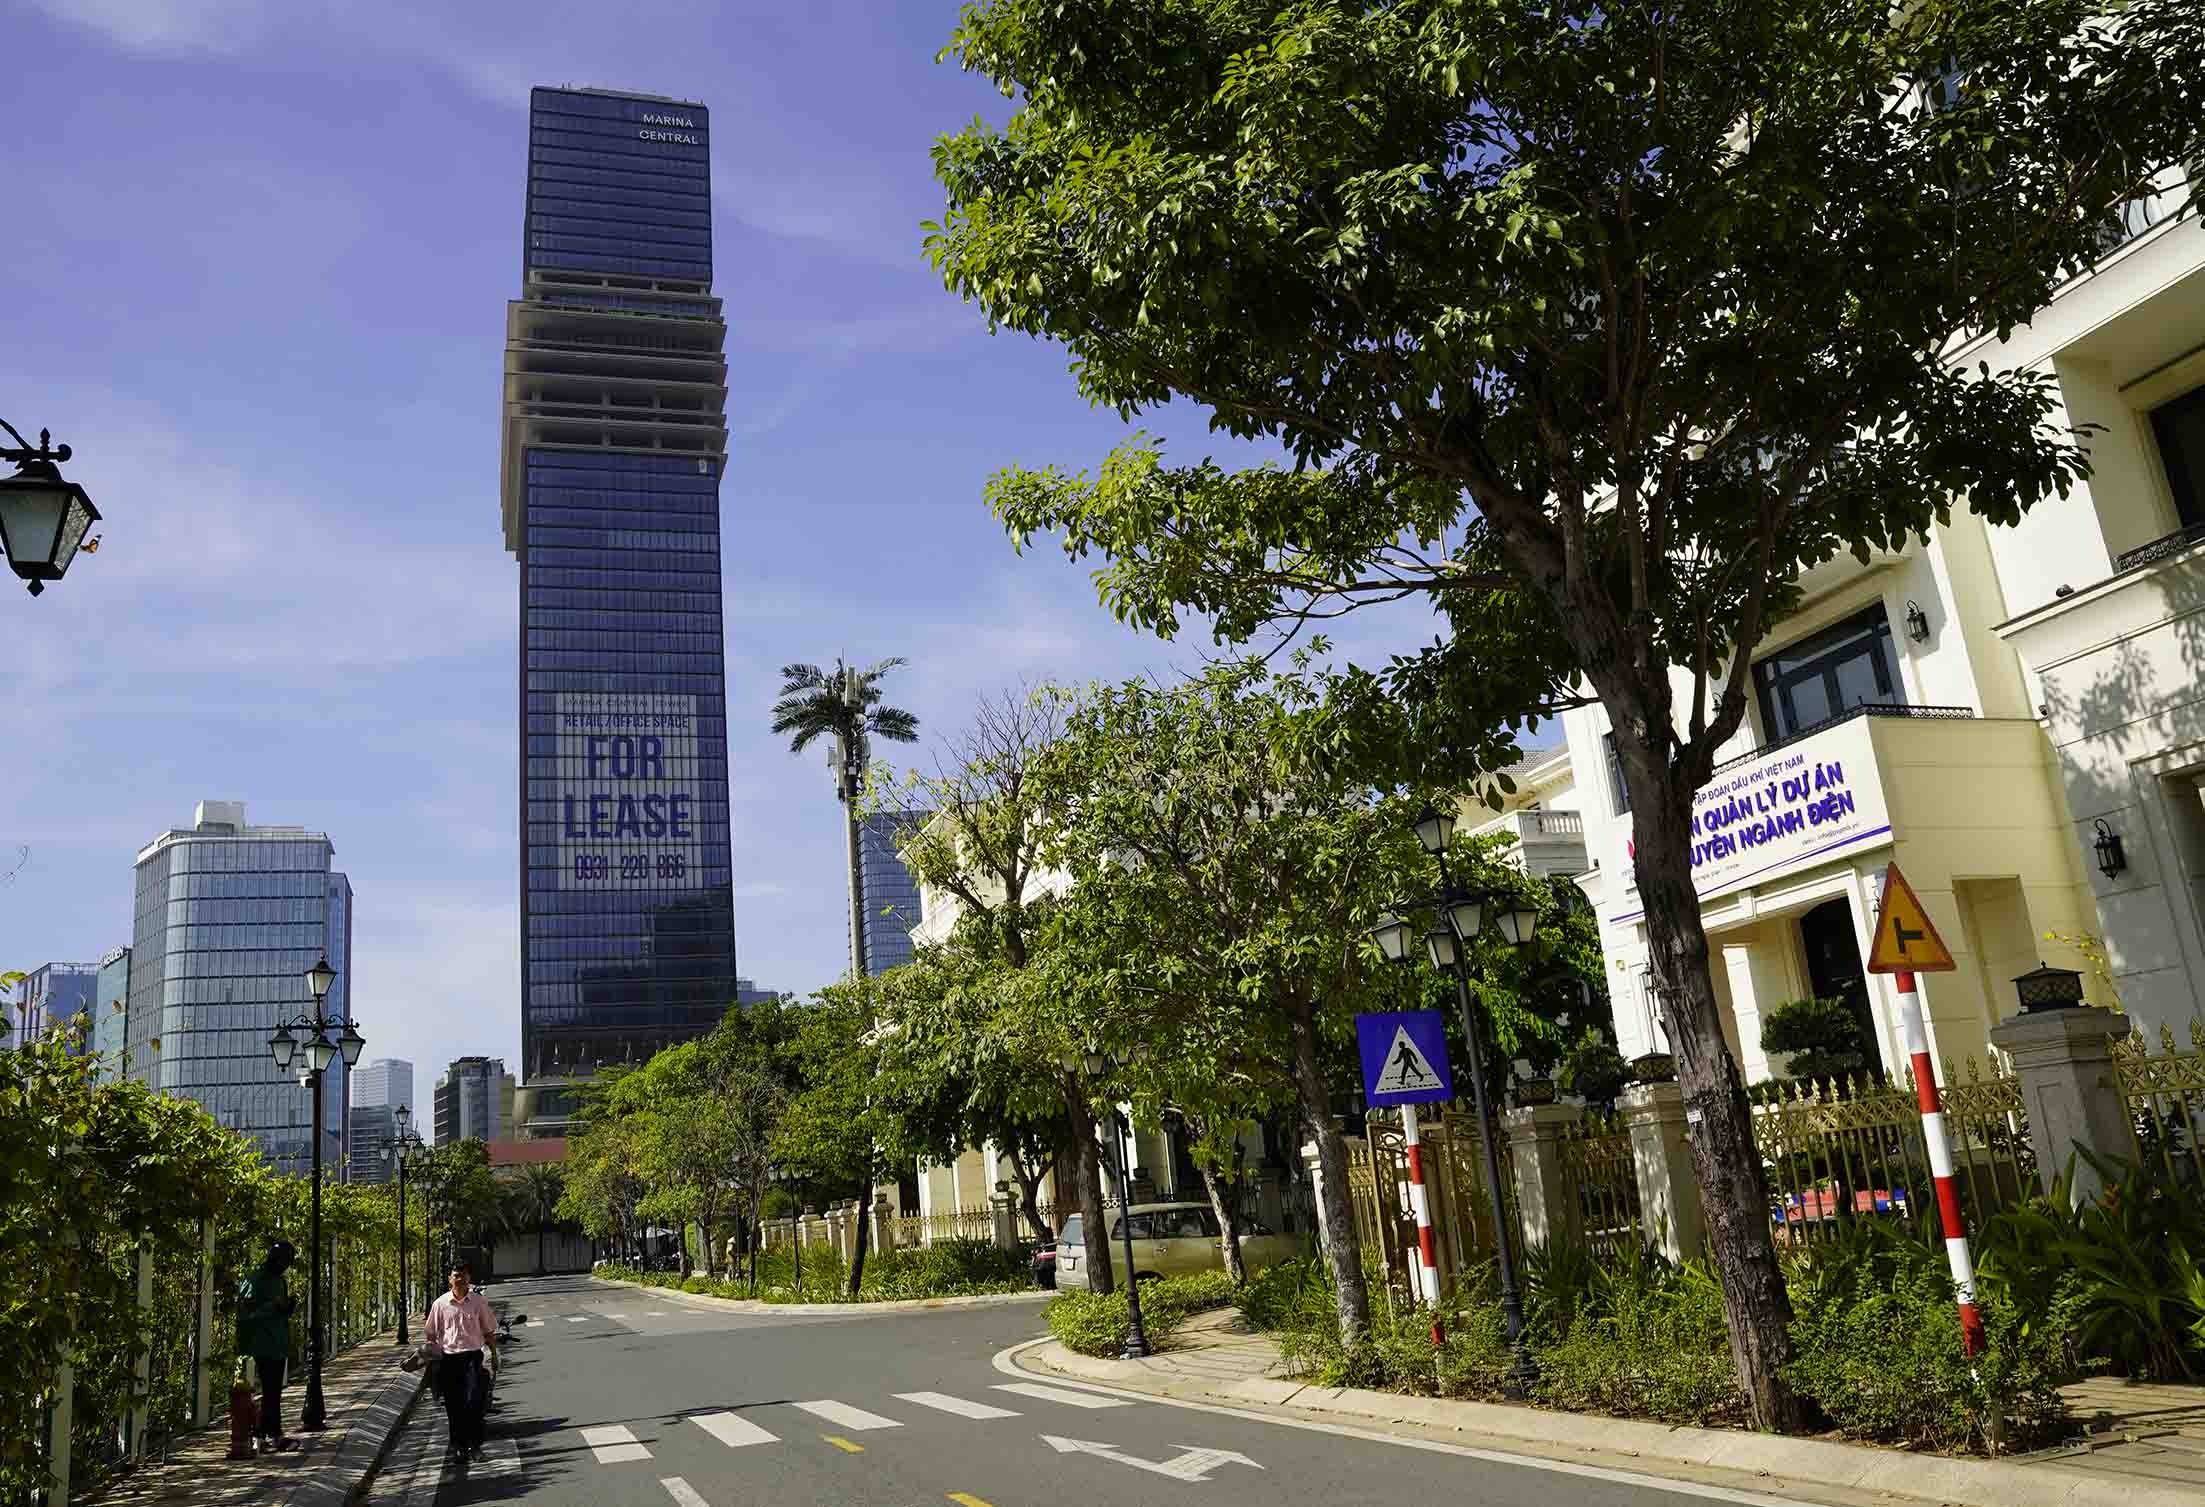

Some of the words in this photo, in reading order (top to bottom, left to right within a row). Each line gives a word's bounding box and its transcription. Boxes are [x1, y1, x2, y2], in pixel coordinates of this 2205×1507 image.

[639, 130, 698, 145] CENTRAL
[643, 114, 694, 128] MARINA
[653, 716, 689, 729] SPACE
[589, 735, 664, 780] FOR
[1750, 767, 1764, 784] KHÍ
[1764, 761, 1783, 777] VIỆT
[1784, 753, 1805, 770] NAM
[1704, 795, 1754, 832] QUẢN
[1755, 781, 1778, 813] LÝ
[1782, 769, 1811, 803] DỰ
[1815, 761, 1844, 792] ÁN
[564, 794, 690, 837] LEASE
[1739, 808, 1805, 851] NGÀNH
[1806, 790, 1855, 827] ĐIỆN
